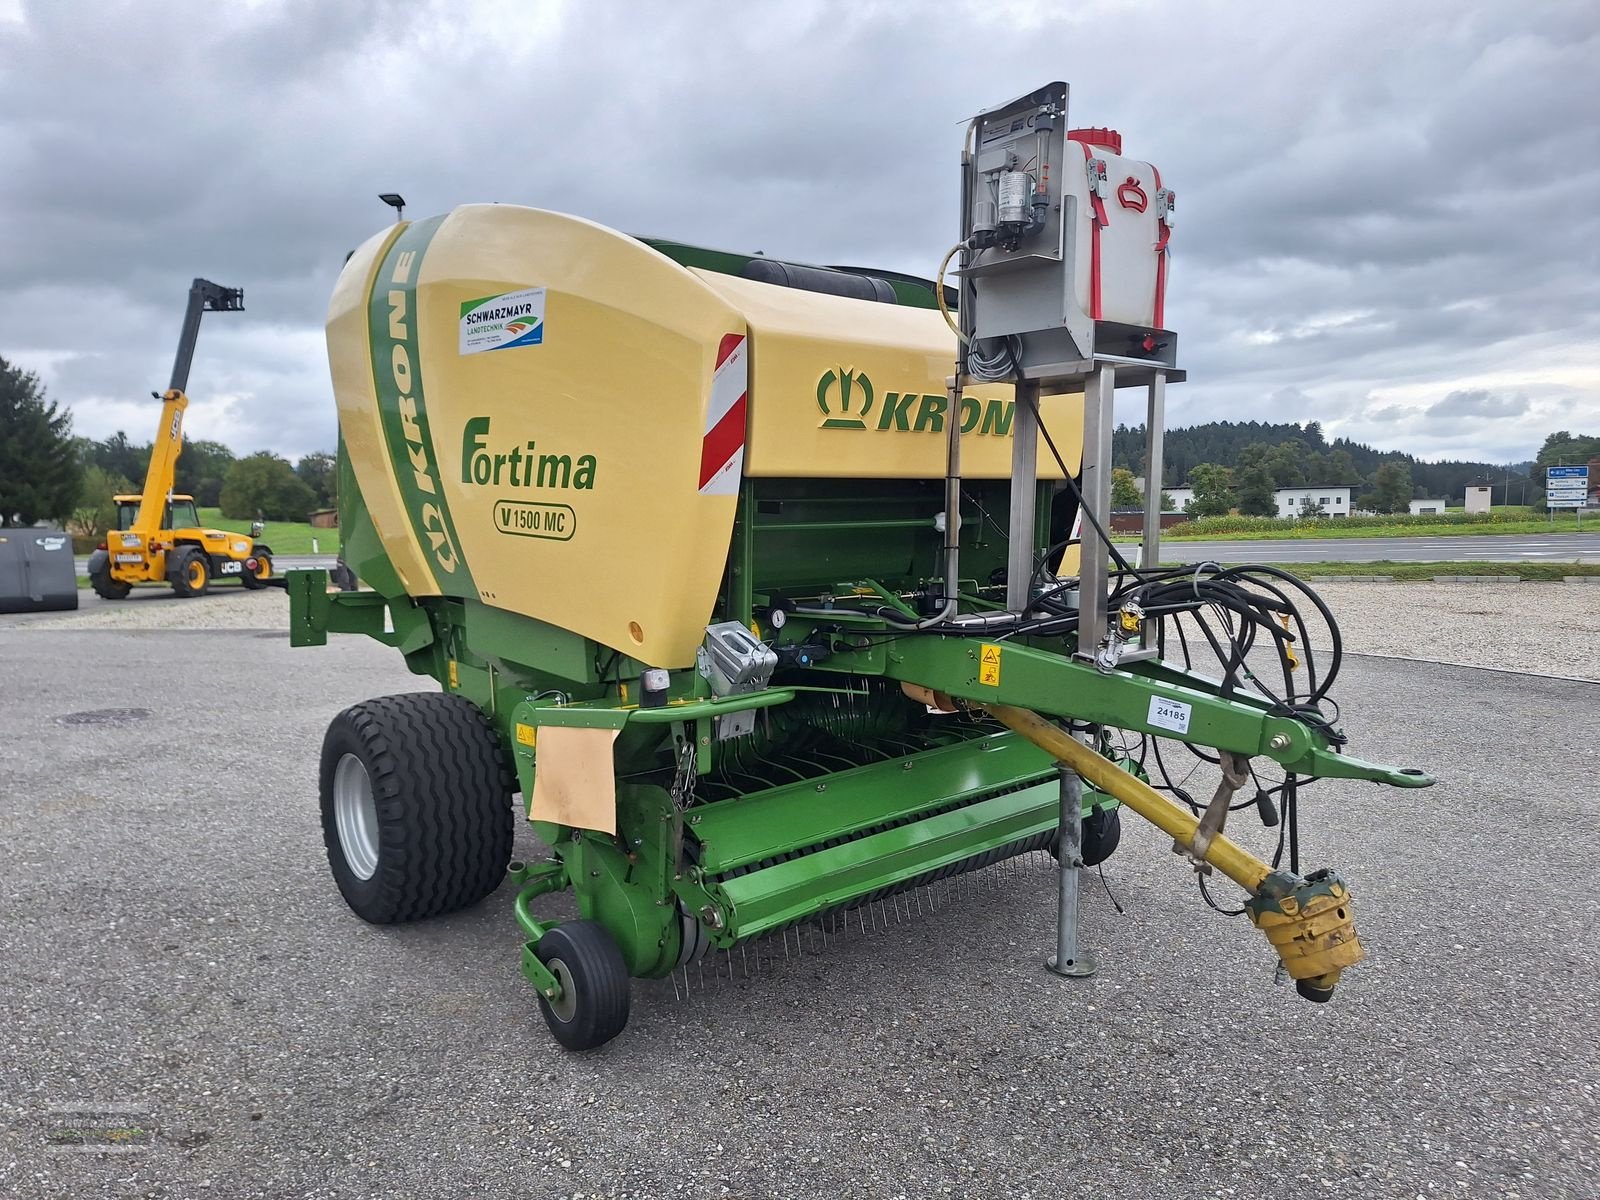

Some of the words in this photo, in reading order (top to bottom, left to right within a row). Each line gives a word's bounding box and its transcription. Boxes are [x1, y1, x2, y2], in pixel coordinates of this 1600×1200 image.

[466, 303, 532, 325] SCHWARZMAYR
[467, 323, 504, 336] LANDTECHNIK
[388, 250, 436, 494] KRONE
[170, 409, 181, 440] JCB
[877, 392, 1015, 437] KRON
[462, 416, 597, 490] Fortima
[514, 510, 541, 530] 1500
[544, 511, 565, 533] MC
[221, 561, 242, 574] JCB
[1157, 706, 1186, 721] 24185
